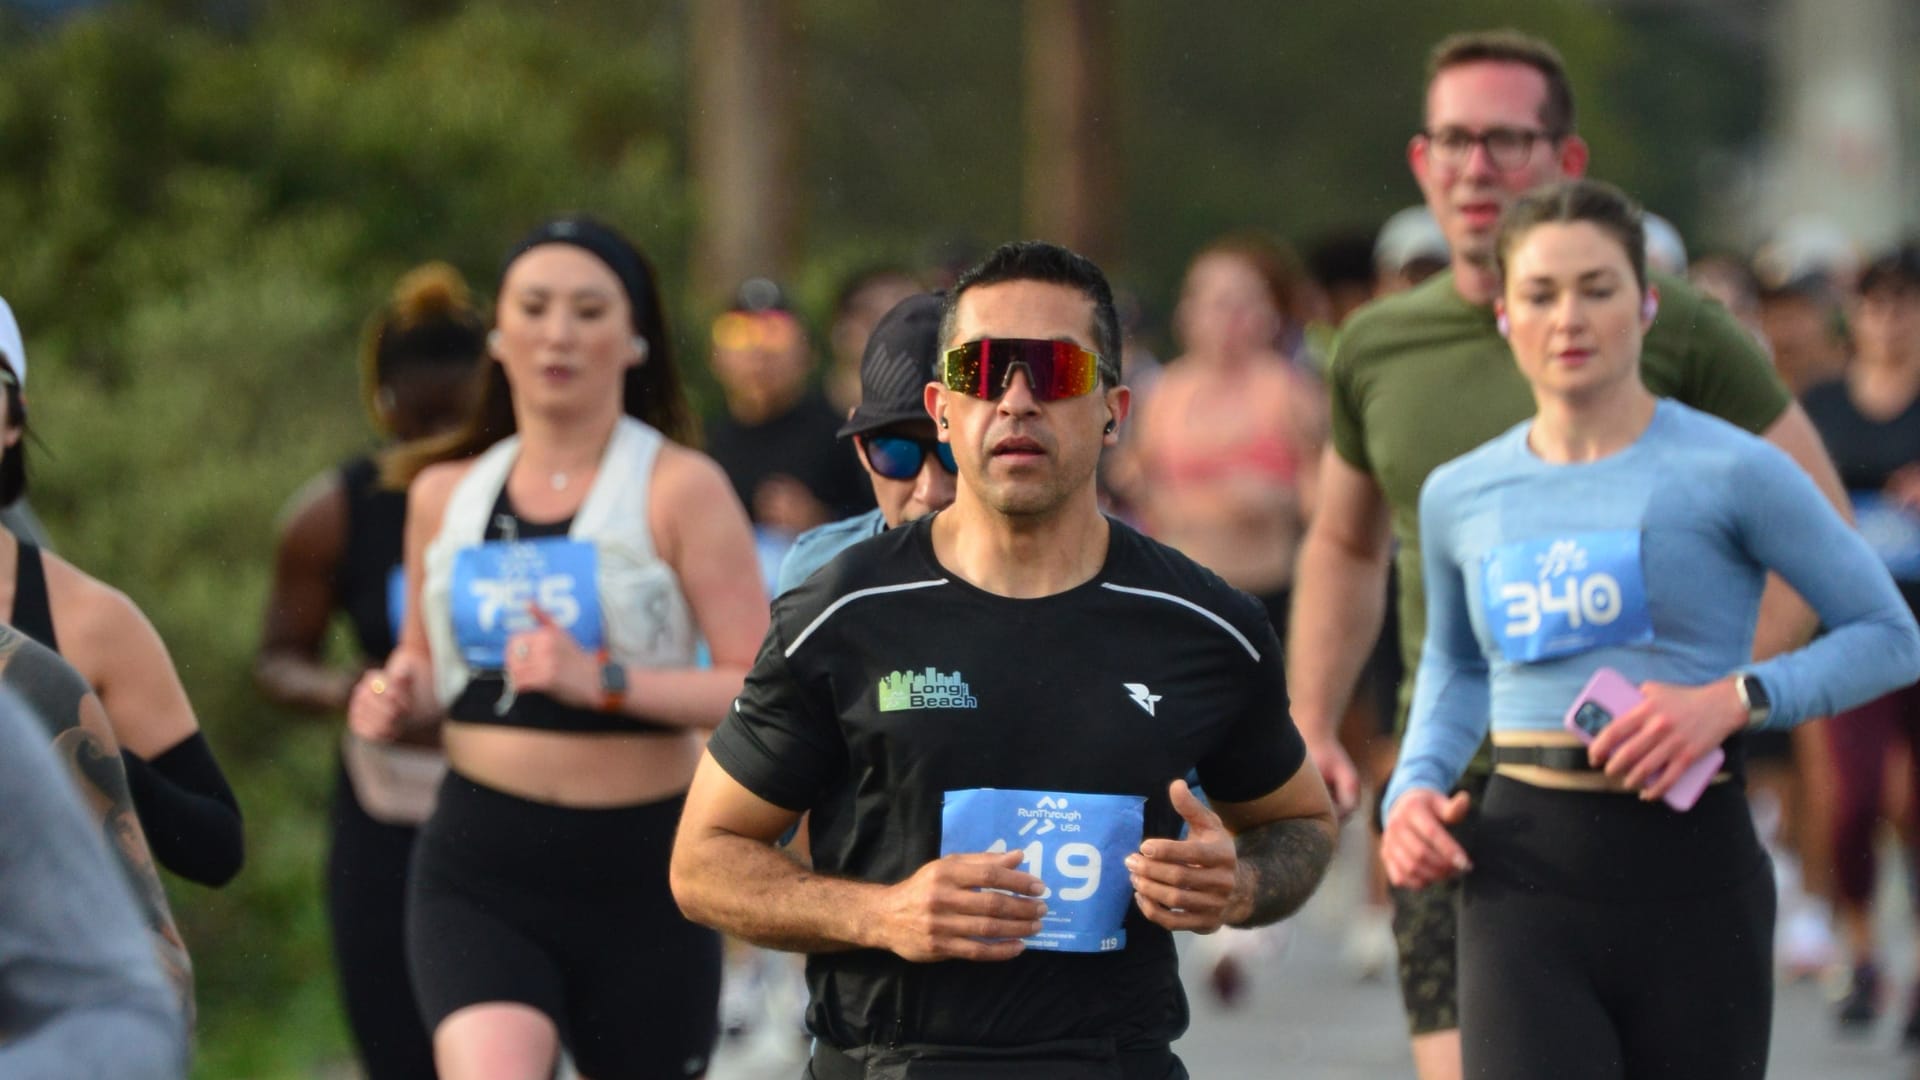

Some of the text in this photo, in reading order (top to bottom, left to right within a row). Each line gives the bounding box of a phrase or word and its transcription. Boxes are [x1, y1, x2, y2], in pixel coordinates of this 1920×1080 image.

[1501, 574, 1621, 638] 340
[909, 682, 961, 696] Long
[910, 695, 977, 708] Beach
[1017, 808, 1081, 821] RunThrough
[1060, 823, 1081, 832] USA
[1100, 937, 1117, 950] 119
